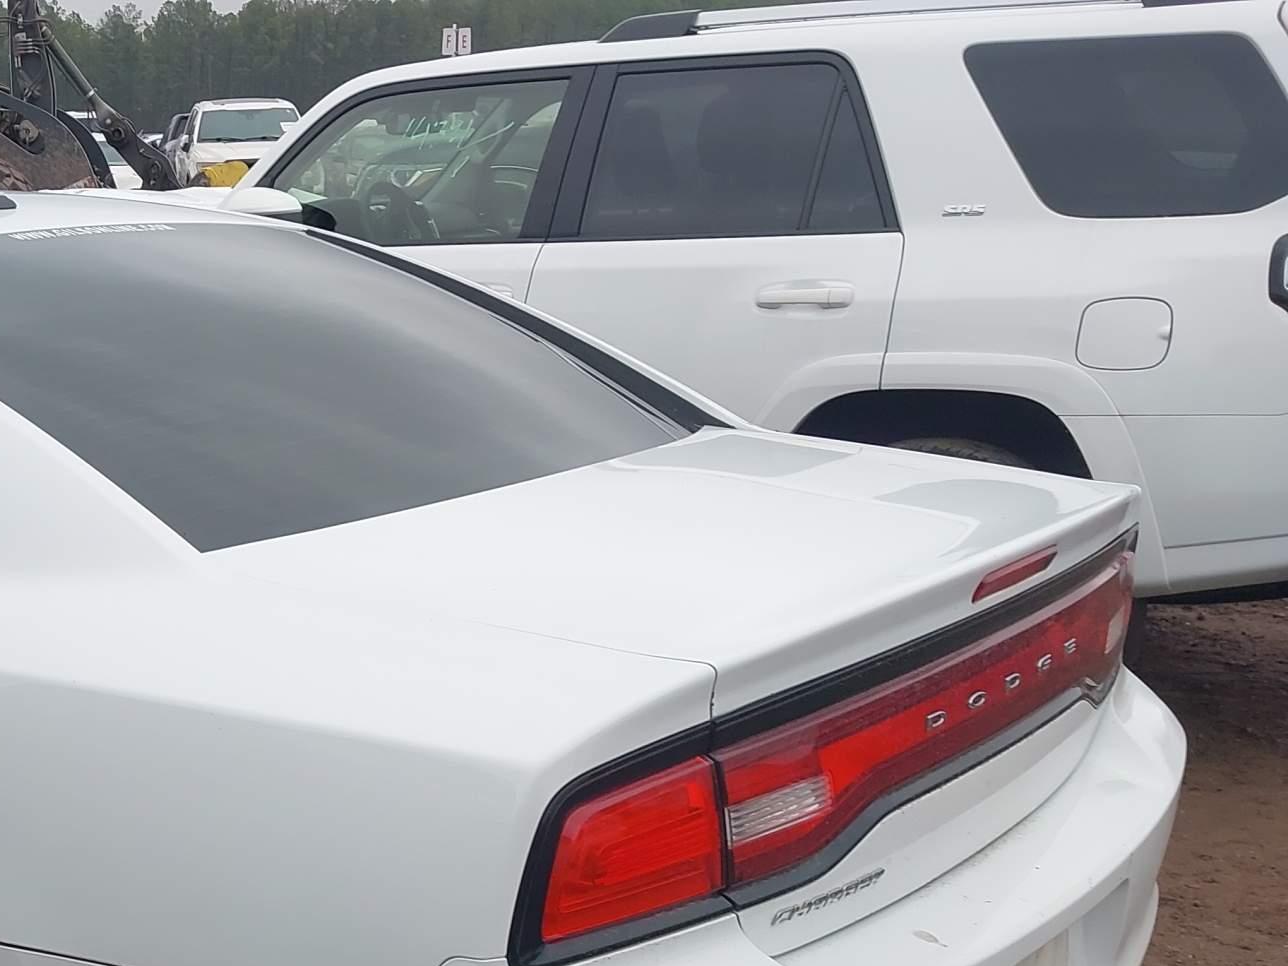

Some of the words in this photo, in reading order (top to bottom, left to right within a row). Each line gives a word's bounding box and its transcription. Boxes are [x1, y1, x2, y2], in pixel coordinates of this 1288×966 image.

[446, 34, 453, 49] F
[462, 34, 468, 49] E
[926, 637, 1077, 728] DODGE
